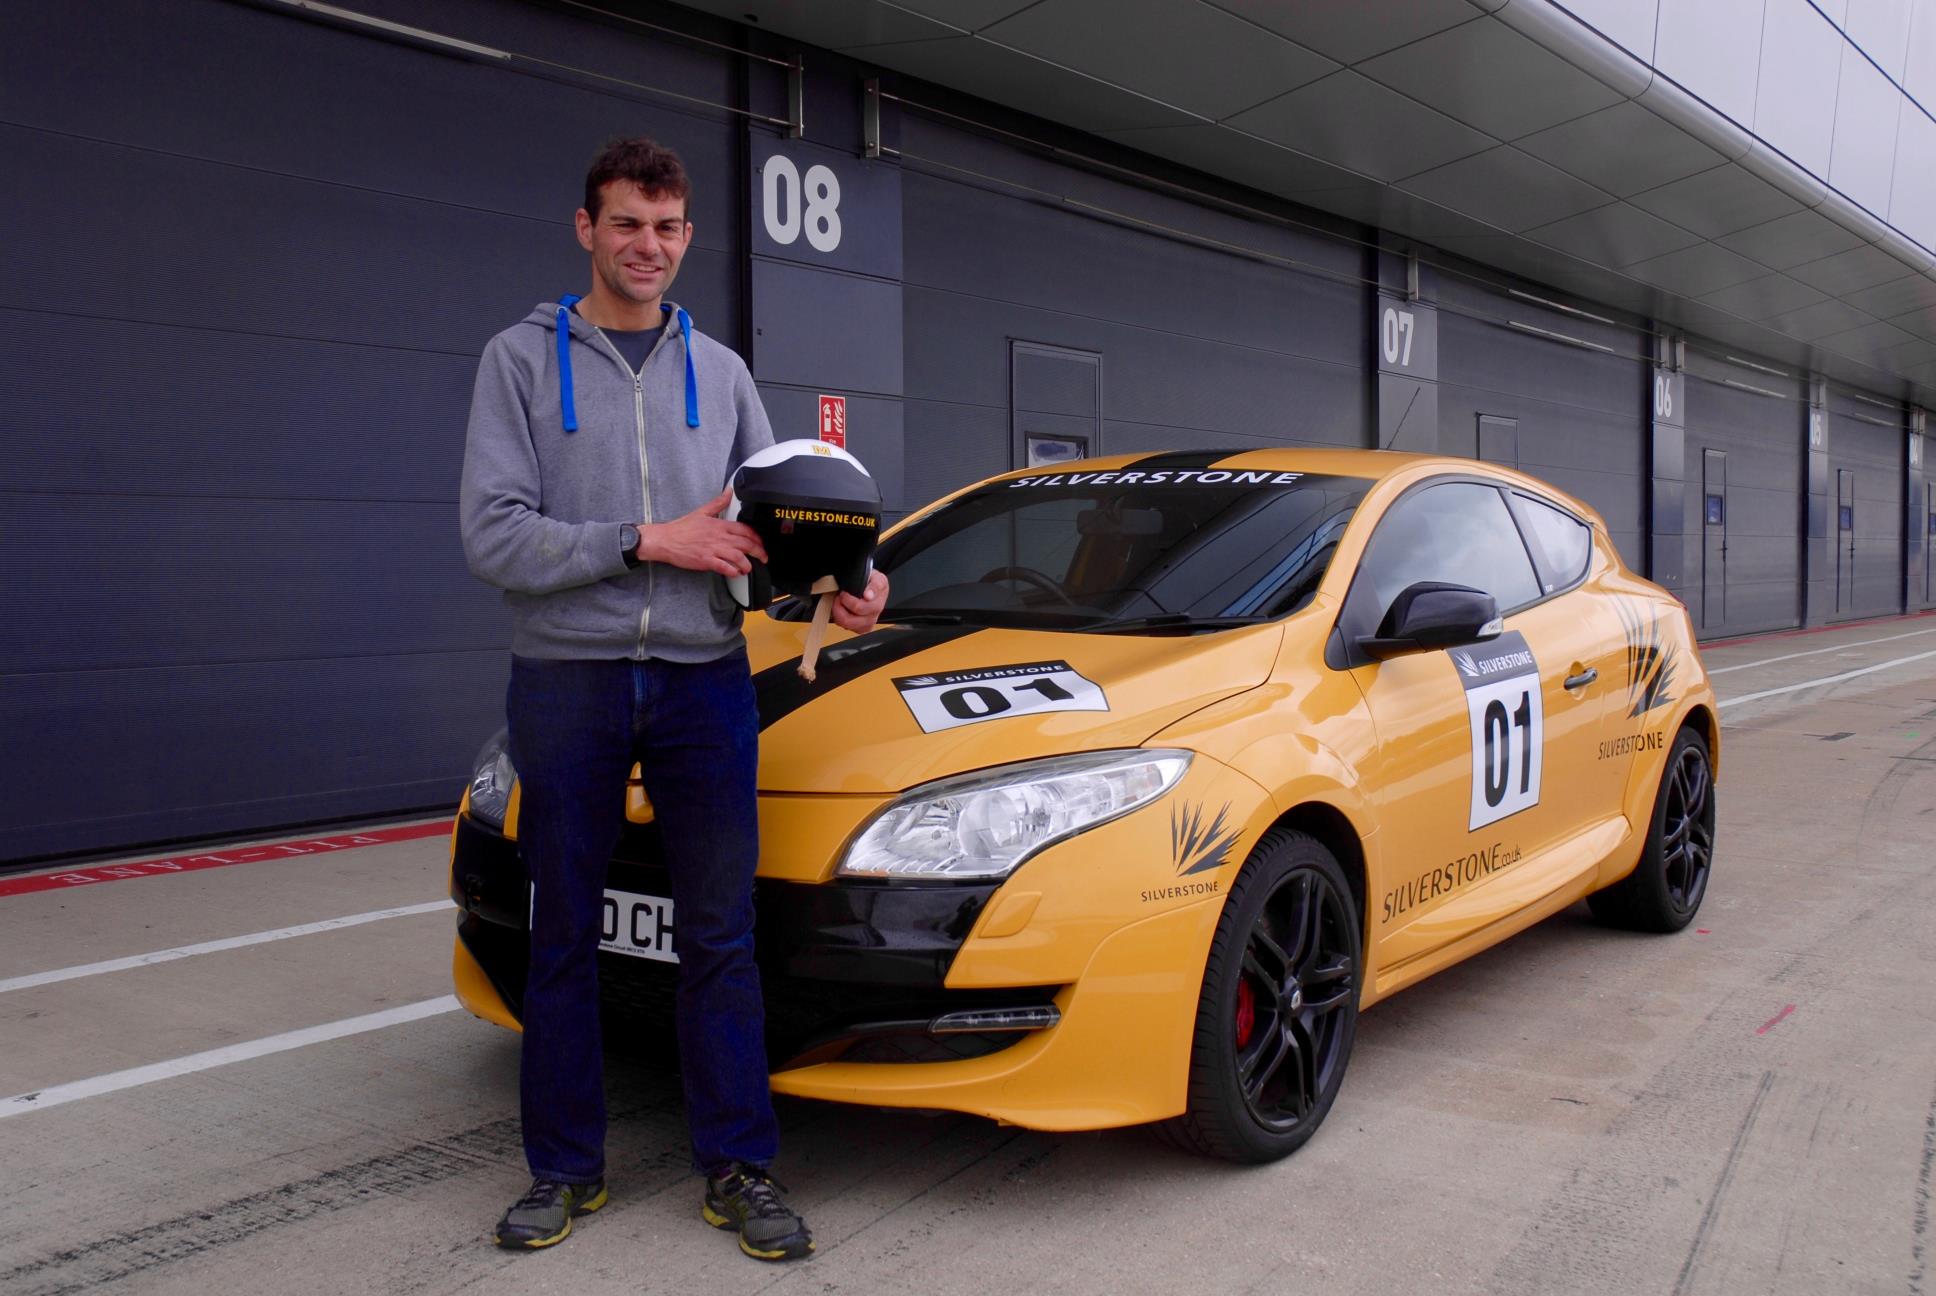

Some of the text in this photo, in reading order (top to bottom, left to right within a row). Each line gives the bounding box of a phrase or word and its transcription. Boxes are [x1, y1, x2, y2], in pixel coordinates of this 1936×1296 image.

[763, 155, 841, 252] 08
[1384, 308, 1413, 366] 07
[1656, 376, 1671, 417] 06
[1811, 413, 1821, 445] 05
[1009, 471, 1304, 488] SILVERSTONE
[775, 508, 876, 527] SILVERSTONE.CO.UK
[945, 665, 1064, 682] SILVERSTONE
[1479, 651, 1533, 674] SILVERSTONE
[940, 678, 1074, 719] 01
[1484, 690, 1531, 807] 01
[1598, 732, 1663, 760] SILVERSTONE
[1141, 881, 1218, 902] SILVERSTONE
